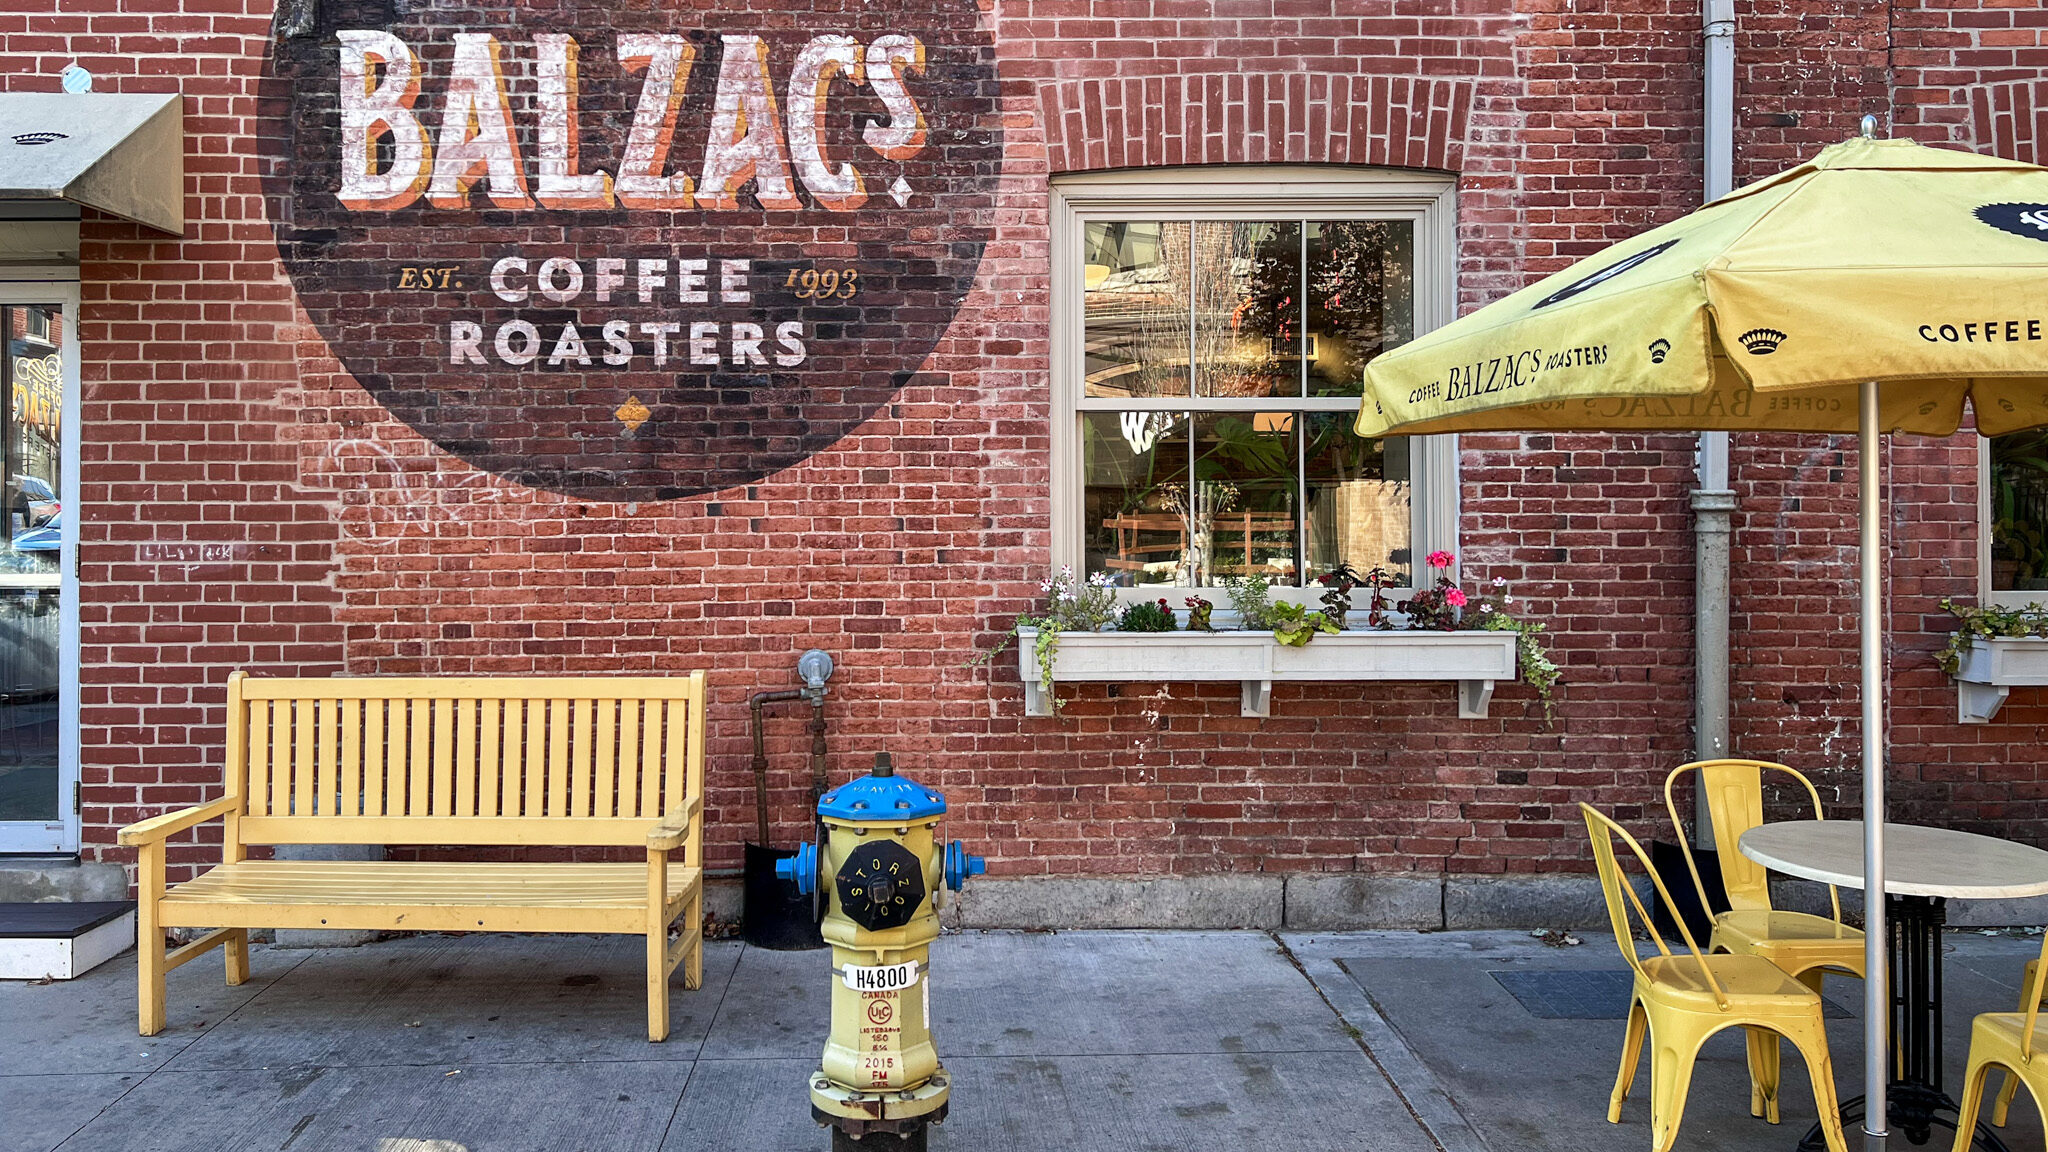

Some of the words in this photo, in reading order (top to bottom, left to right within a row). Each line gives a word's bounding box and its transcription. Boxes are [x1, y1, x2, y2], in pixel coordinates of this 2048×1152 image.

[396, 265, 463, 290] EST.
[489, 256, 751, 303] COFFEE
[784, 267, 858, 300] 1993
[1918, 319, 2042, 343] COFFEE
[449, 319, 807, 367] ROASTERS
[1408, 380, 1441, 404] COFFEE
[1544, 344, 1608, 372] ROASTERS
[856, 966, 907, 989] H4800
[861, 991, 899, 1000] CANADA
[871, 1006, 890, 1020] ULC
[865, 1057, 894, 1069] 2015
[872, 1071, 888, 1080] FM
